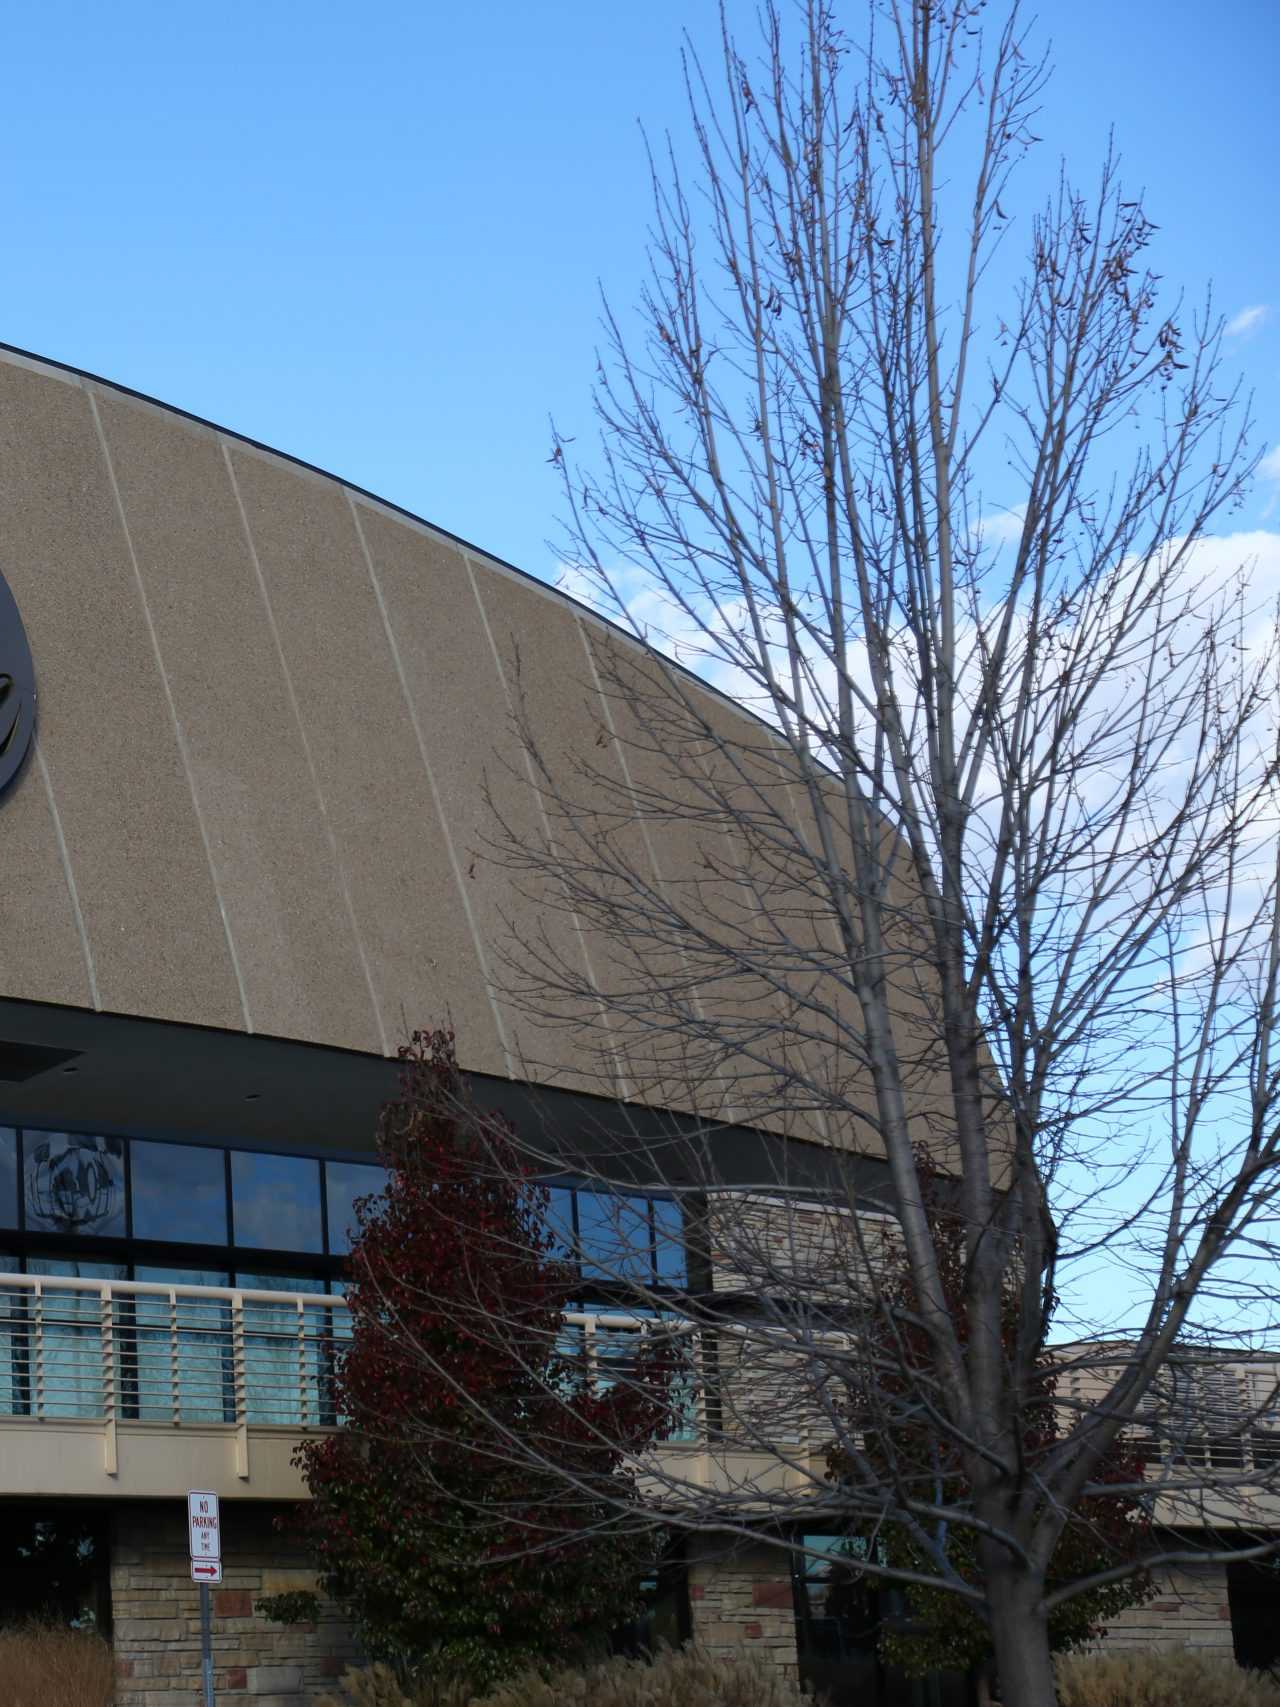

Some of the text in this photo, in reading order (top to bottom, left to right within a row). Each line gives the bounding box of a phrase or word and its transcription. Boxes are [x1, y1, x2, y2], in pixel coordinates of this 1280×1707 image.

[200, 1501, 208, 1513] NO
[192, 1516, 217, 1529] PARKING
[201, 1532, 210, 1540] ANY
[201, 1542, 210, 1551] TIME
